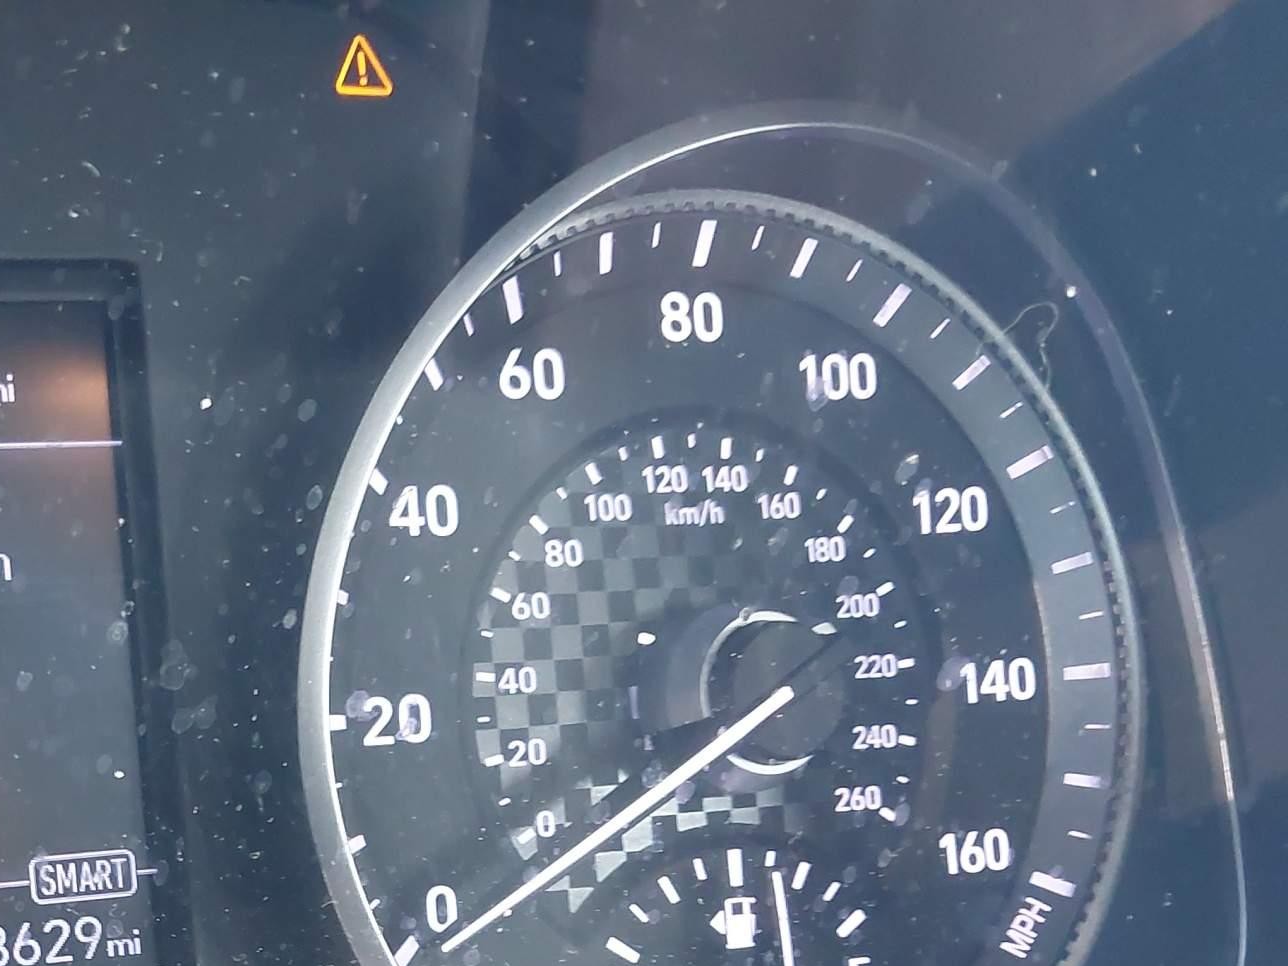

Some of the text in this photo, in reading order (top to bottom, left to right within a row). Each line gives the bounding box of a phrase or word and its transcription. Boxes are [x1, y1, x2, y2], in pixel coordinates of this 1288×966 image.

[660, 291, 724, 343] 80
[498, 348, 566, 400] 60
[799, 352, 877, 402] 100
[642, 465, 688, 494] 120
[701, 464, 748, 494] 140
[388, 484, 458, 537] 40
[584, 493, 633, 522] 100
[663, 499, 726, 528] km/h
[756, 493, 801, 521] 160
[912, 486, 988, 533] 120
[545, 538, 584, 567] 80
[804, 535, 846, 564] 180
[512, 592, 551, 621] 60
[836, 593, 879, 619] 200
[498, 666, 538, 695] 40
[854, 653, 898, 681] 220
[961, 658, 1036, 706] 140
[363, 694, 432, 746] 20
[852, 725, 898, 751] 240
[507, 739, 548, 768] 20
[834, 785, 882, 812] 260
[535, 810, 557, 839] 0
[939, 828, 1011, 876] 160
[39, 857, 130, 898] SMART
[426, 884, 459, 934] 0
[999, 897, 1053, 960] MPH
